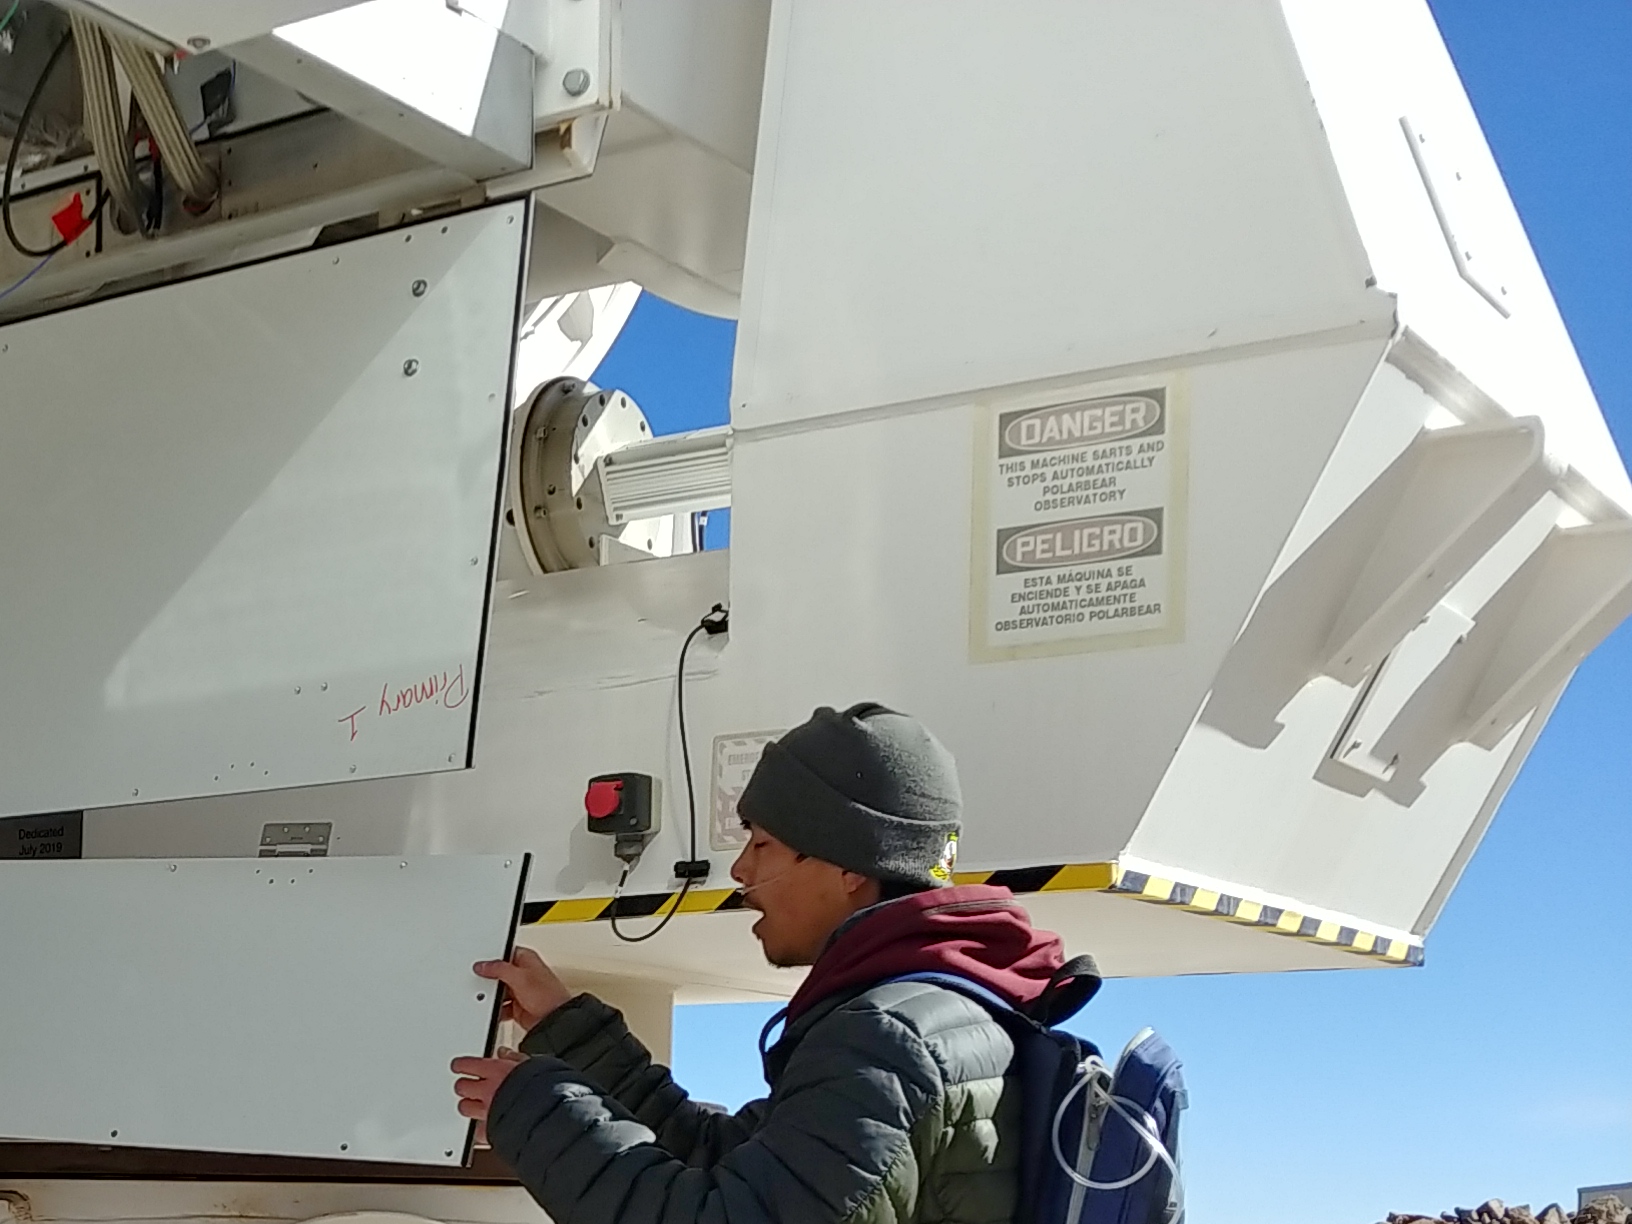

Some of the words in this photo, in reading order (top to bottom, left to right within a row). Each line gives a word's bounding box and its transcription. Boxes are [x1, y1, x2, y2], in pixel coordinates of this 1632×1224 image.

[1021, 402, 1147, 446] DANGER
[998, 461, 1026, 476] THIS
[1030, 452, 1088, 470] MACHINE
[1092, 445, 1134, 461] SARTS
[1137, 440, 1165, 455] AND
[1007, 473, 1048, 488] STOPS
[1051, 456, 1156, 481] AUTOMATICALLY
[1034, 489, 1126, 512] OBSERVATORY
[1042, 477, 1117, 497] POLARBEAR
[1015, 521, 1144, 562] PELIGRO
[1010, 587, 1071, 604] ENCIENDE
[1074, 585, 1083, 596] Y
[1085, 582, 1102, 595] SE
[1105, 577, 1146, 593] APAGA
[1023, 575, 1053, 589] ESTA
[1056, 568, 1113, 585] MÁQUINA
[1116, 565, 1133, 578] SE
[994, 613, 1085, 632] OBSERVATORIO
[1088, 603, 1162, 622] POLARBEAR
[1018, 593, 1137, 616] AUTOMATICAMENTE
[379, 664, 469, 716] Primary
[18, 826, 65, 840] Dedicated
[19, 844, 38, 857] July
[39, 842, 63, 855] 2019
